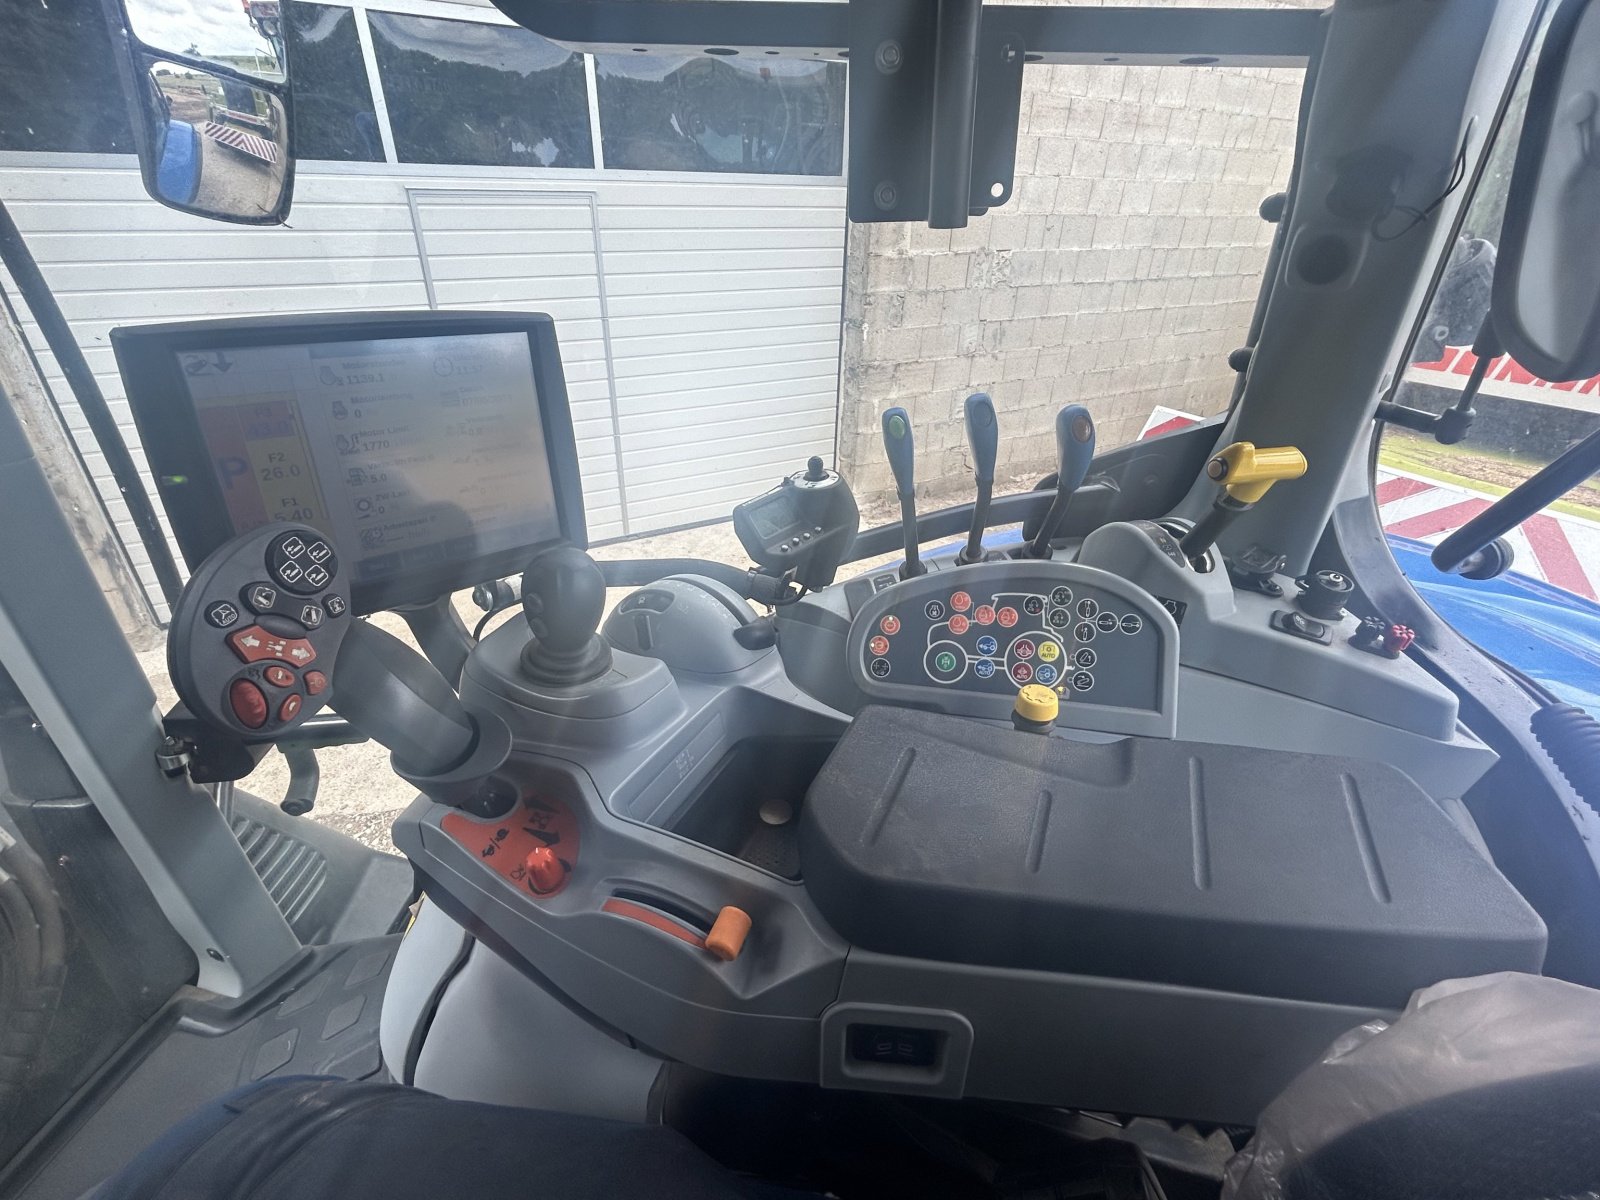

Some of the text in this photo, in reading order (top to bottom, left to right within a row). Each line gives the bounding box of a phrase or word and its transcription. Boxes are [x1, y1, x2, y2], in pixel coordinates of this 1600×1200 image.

[346, 373, 385, 385] 1139.1
[363, 440, 390, 452] 1770
[268, 452, 286, 463] F2
[219, 456, 248, 489] P
[261, 465, 300, 481] 26.0
[370, 473, 387, 483] 5.0
[281, 498, 299, 508] F1
[222, 613, 236, 624] AUTO
